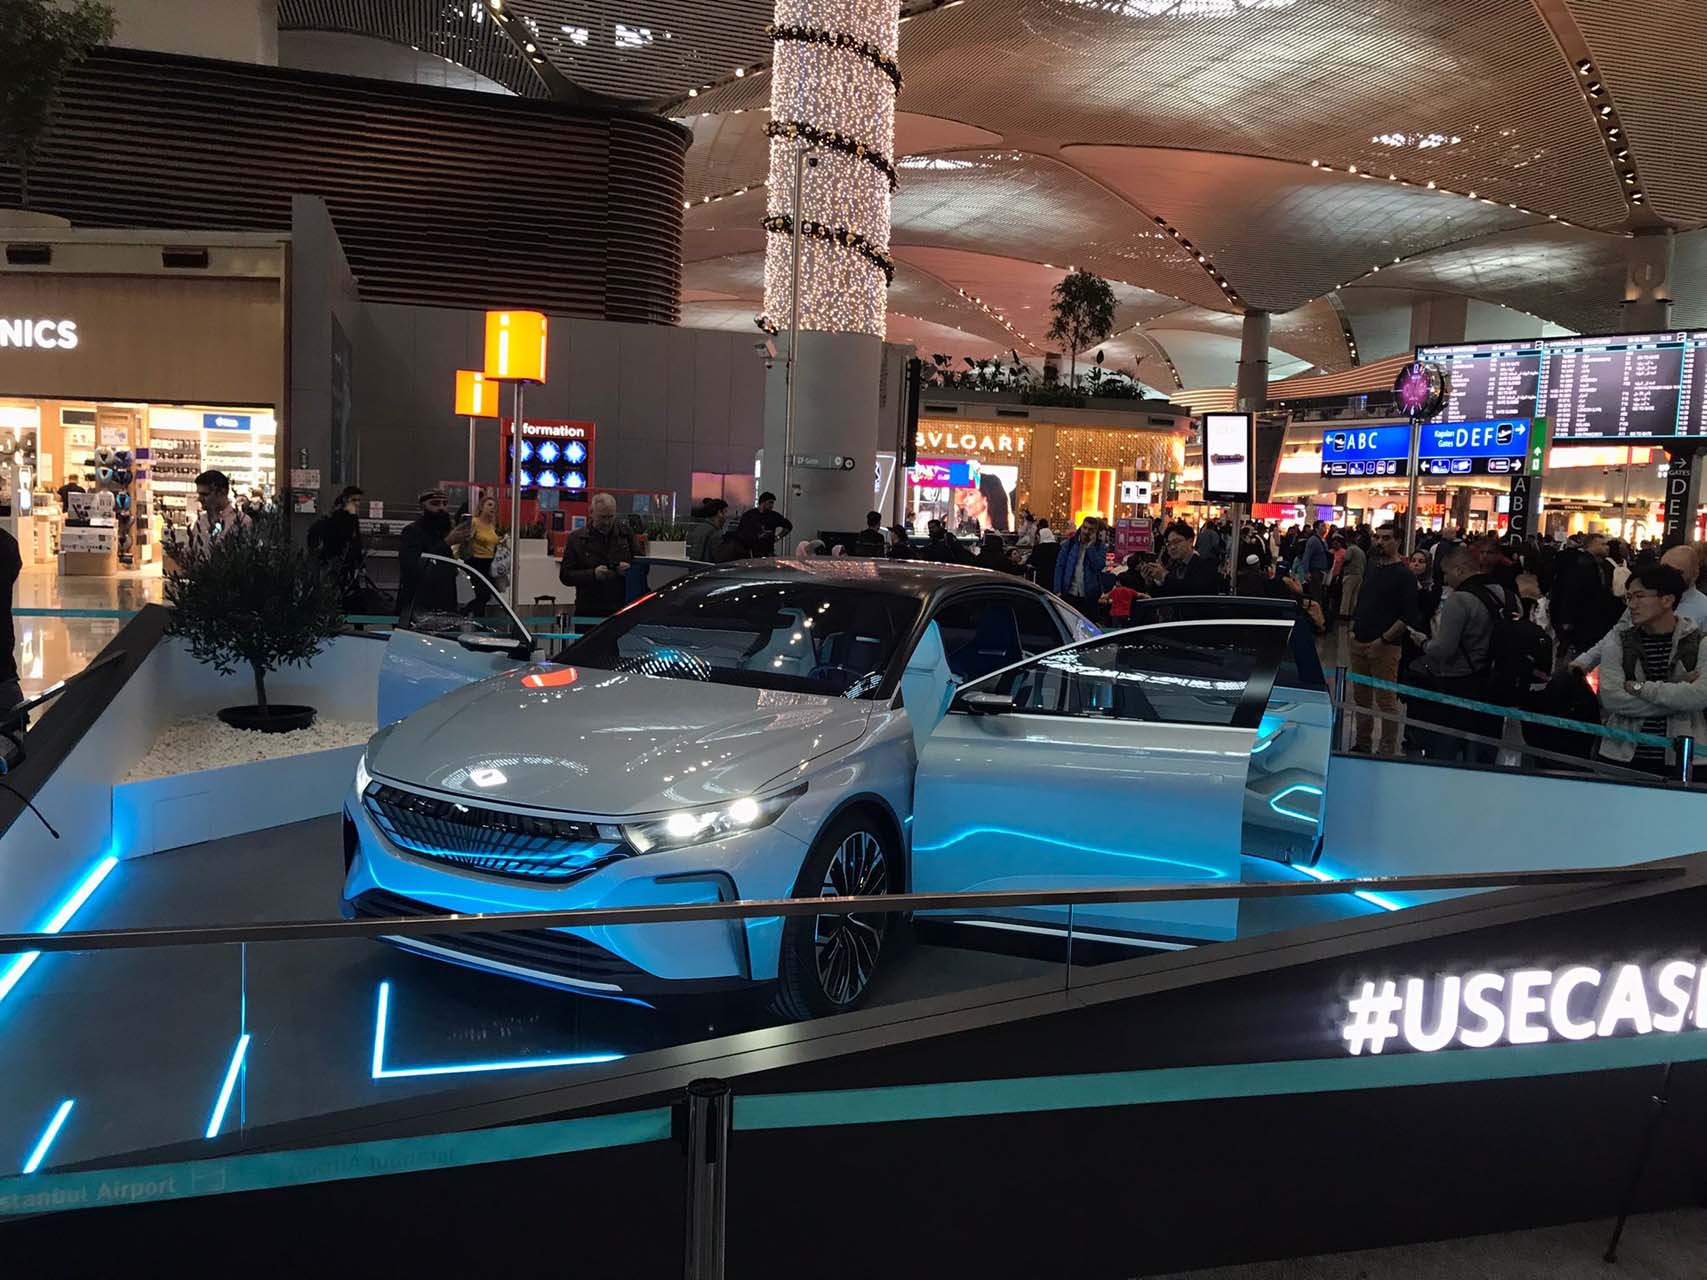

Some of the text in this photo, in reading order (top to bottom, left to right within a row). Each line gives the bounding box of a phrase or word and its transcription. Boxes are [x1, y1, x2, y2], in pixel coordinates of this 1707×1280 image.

[0, 319, 78, 349] NICS
[511, 422, 584, 437] iformation
[1343, 961, 1707, 1056] #USECAS
[97, 1175, 176, 1201] Airport
